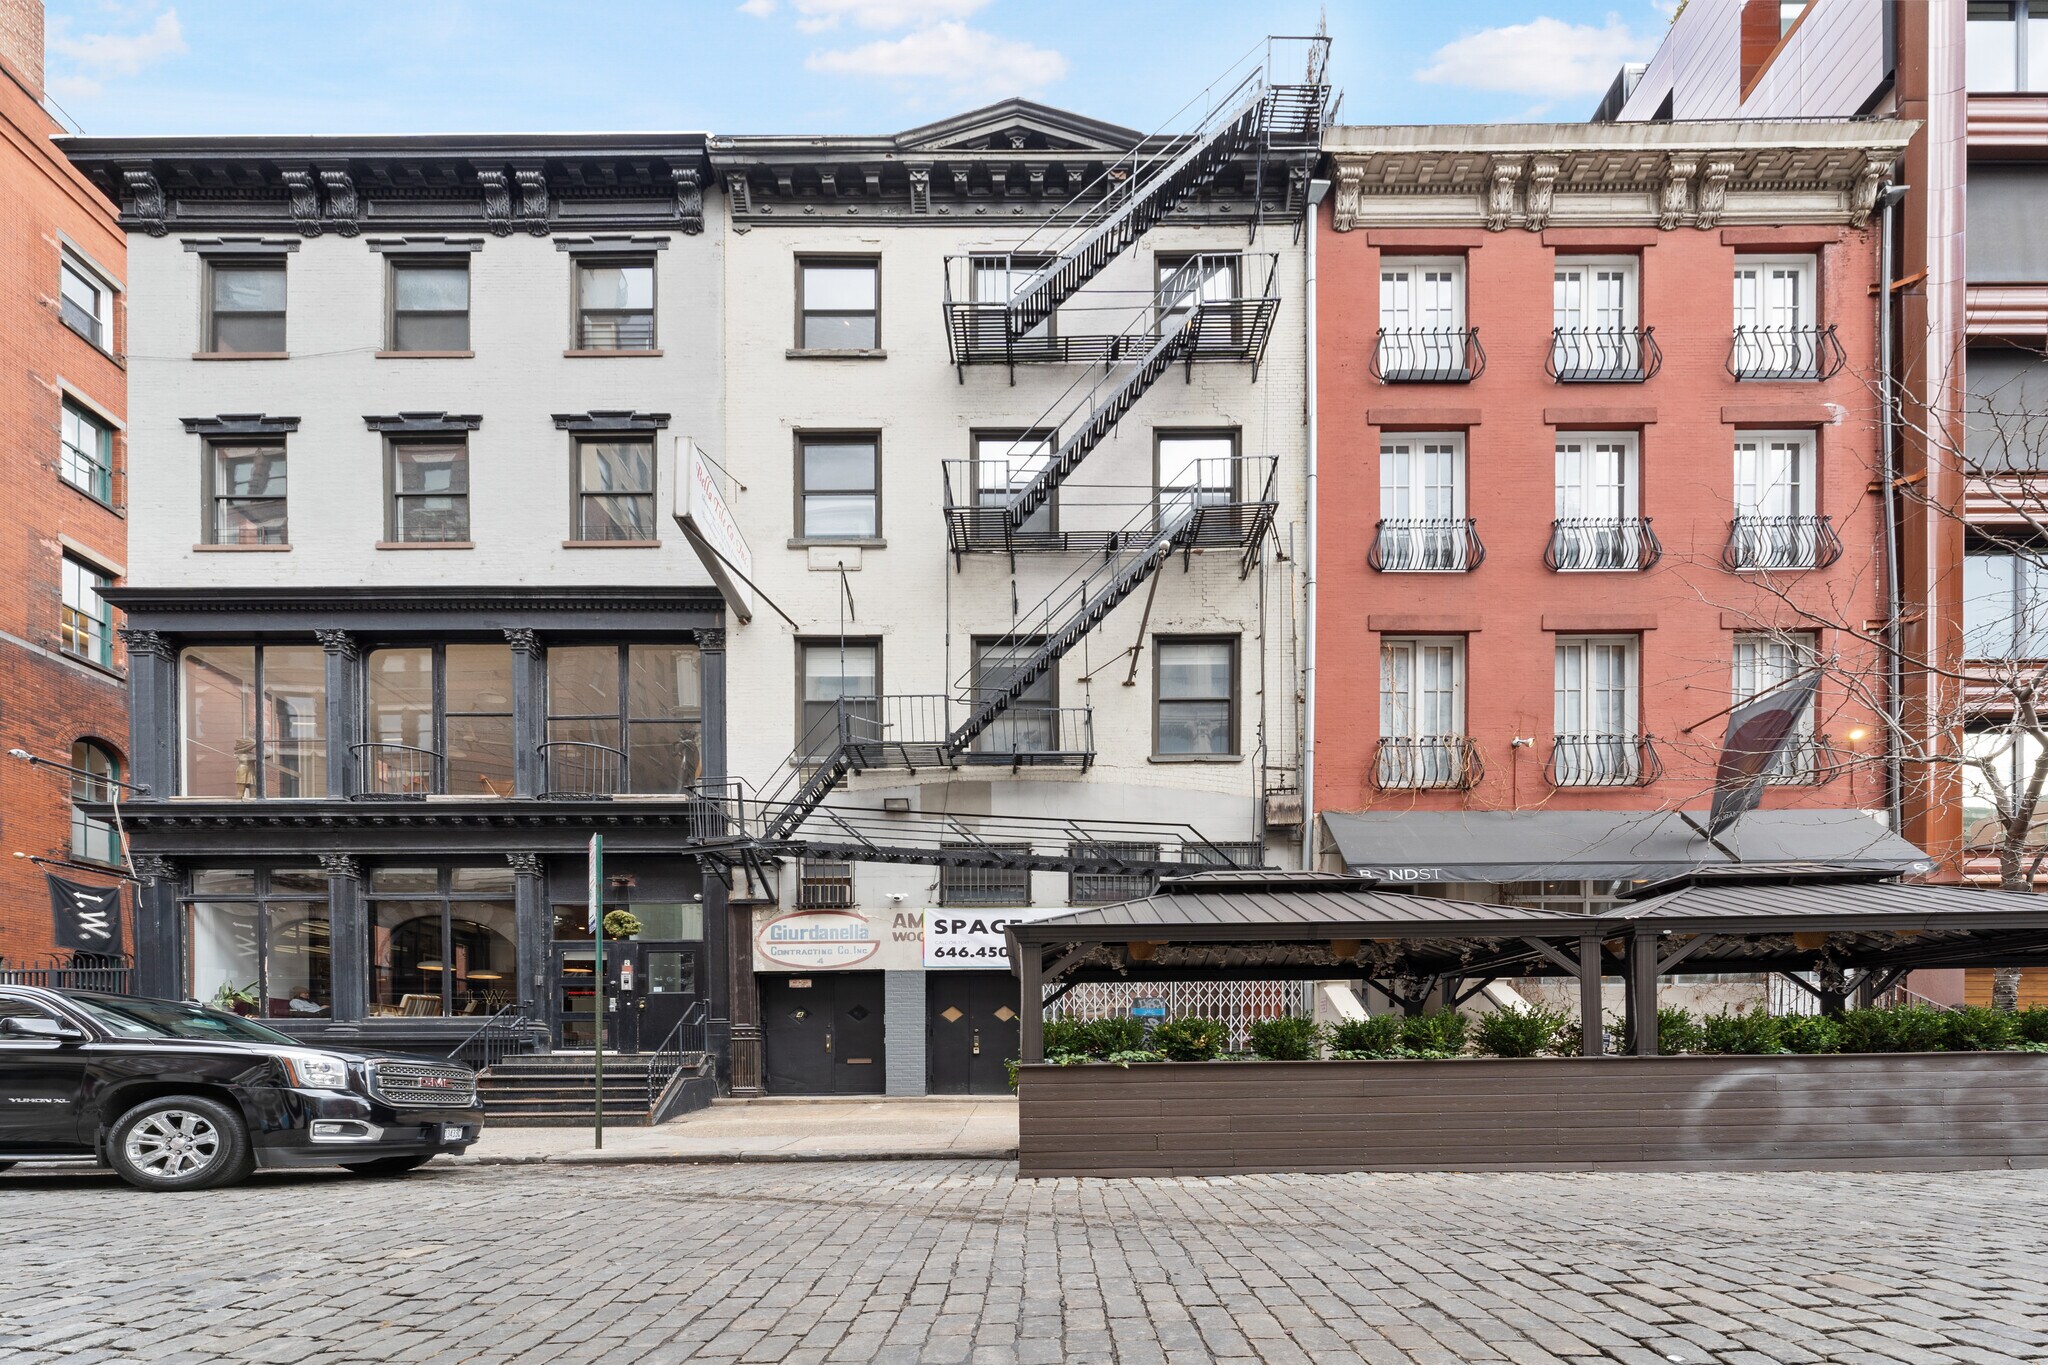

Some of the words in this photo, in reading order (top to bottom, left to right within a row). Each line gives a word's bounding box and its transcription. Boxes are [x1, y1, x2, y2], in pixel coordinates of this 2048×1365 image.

[770, 924, 869, 941] Giurdanella
[934, 919, 1023, 935] SPAC
[419, 1077, 455, 1090] GMC
